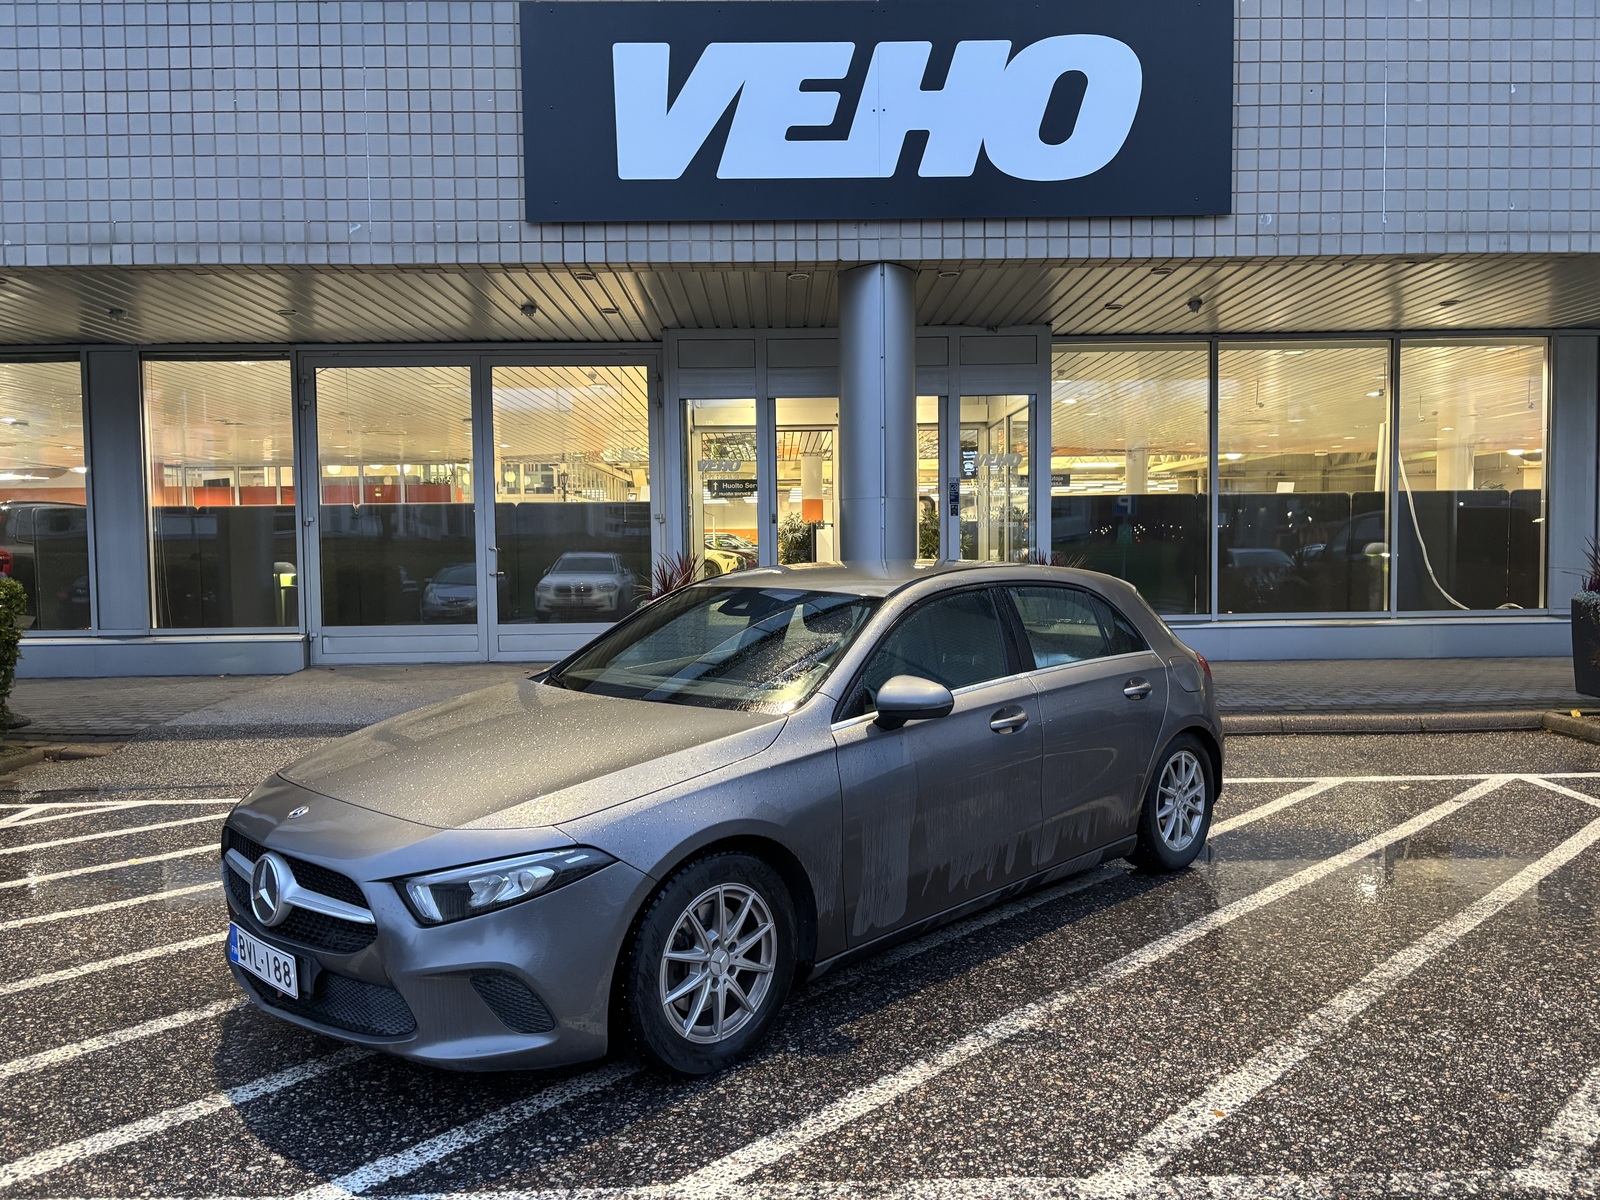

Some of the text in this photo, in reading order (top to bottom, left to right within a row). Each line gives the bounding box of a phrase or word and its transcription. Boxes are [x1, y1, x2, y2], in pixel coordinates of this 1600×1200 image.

[612, 34, 1142, 181] VEHO
[698, 460, 742, 472] VEHO
[974, 453, 1023, 467] VEHO
[239, 934, 292, 988] BYL-188
